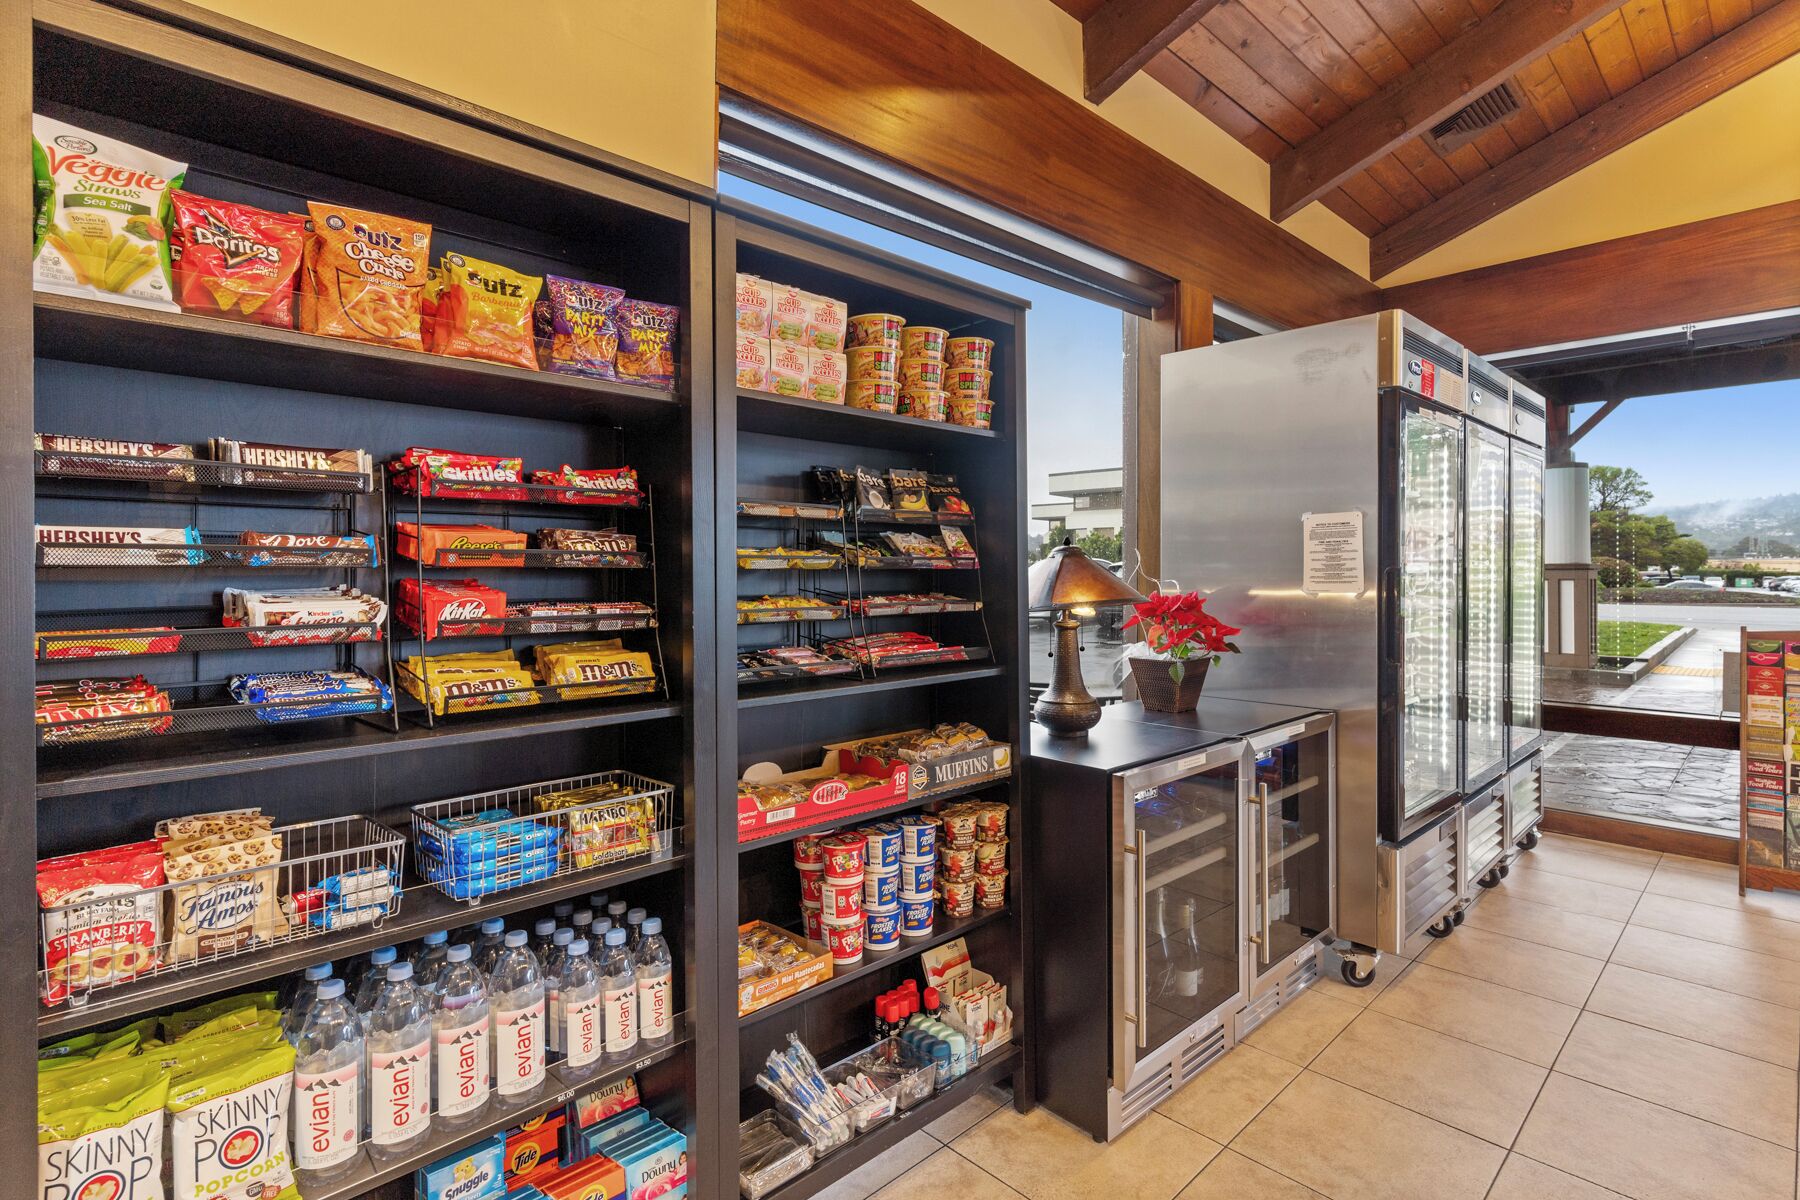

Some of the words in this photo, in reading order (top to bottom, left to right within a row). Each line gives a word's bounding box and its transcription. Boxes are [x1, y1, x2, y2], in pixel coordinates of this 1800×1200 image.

[46, 145, 165, 192] Veggie
[74, 179, 142, 199] Straws
[83, 196, 106, 207] Sea
[110, 200, 133, 212] Salt
[196, 226, 280, 262] Doritos
[345, 241, 414, 272] Cheese
[359, 258, 405, 281] Curls
[736, 293, 767, 310] NOODLES
[742, 287, 760, 297] CUP
[785, 297, 801, 307] CUP
[566, 307, 606, 328] PARTY
[815, 312, 842, 325] NOODLES
[822, 307, 837, 317] CUP
[574, 325, 597, 339] MIX
[631, 329, 668, 343] PARTY
[639, 342, 663, 354] MIX
[736, 350, 765, 365] NOODLES
[742, 344, 759, 354] CUP
[783, 353, 799, 362] CUP
[776, 358, 804, 373] NOODLES
[813, 366, 841, 378] NOODLES
[821, 360, 837, 369] CUP
[56, 437, 154, 458] HERSHEY'S
[245, 448, 330, 470] HERSHEY'S
[442, 466, 517, 482] Skittles
[576, 476, 635, 490] Skittles
[857, 468, 886, 488] bare
[892, 472, 927, 487] bare
[39, 530, 142, 545] HERSHEY'S
[451, 536, 501, 550] Reese's
[441, 599, 486, 621] KitKat
[296, 616, 344, 625] bueno
[894, 771, 906, 785] 18
[935, 755, 989, 783] MUFFINS
[579, 807, 626, 825] HARIBO
[835, 859, 858, 873] LOOPS
[180, 881, 264, 922] Famous
[186, 900, 255, 935] Amos
[54, 923, 146, 952] STRAWBERRY
[781, 973, 794, 986] Mini
[653, 989, 664, 1028] evian
[618, 1000, 630, 1041] evian
[580, 1013, 593, 1054] evian
[514, 1023, 532, 1078] evian
[457, 1042, 475, 1098] evian
[389, 1068, 410, 1127] evian
[589, 1082, 625, 1104] Downy
[194, 1084, 283, 1139] SKINNY
[309, 1092, 330, 1153] evian
[45, 1121, 153, 1182] SKINNY
[515, 1150, 537, 1172] Tide
[193, 1151, 286, 1198] POPCORN
[641, 1159, 677, 1184] Downy
[445, 1171, 489, 1200] Snuggle
